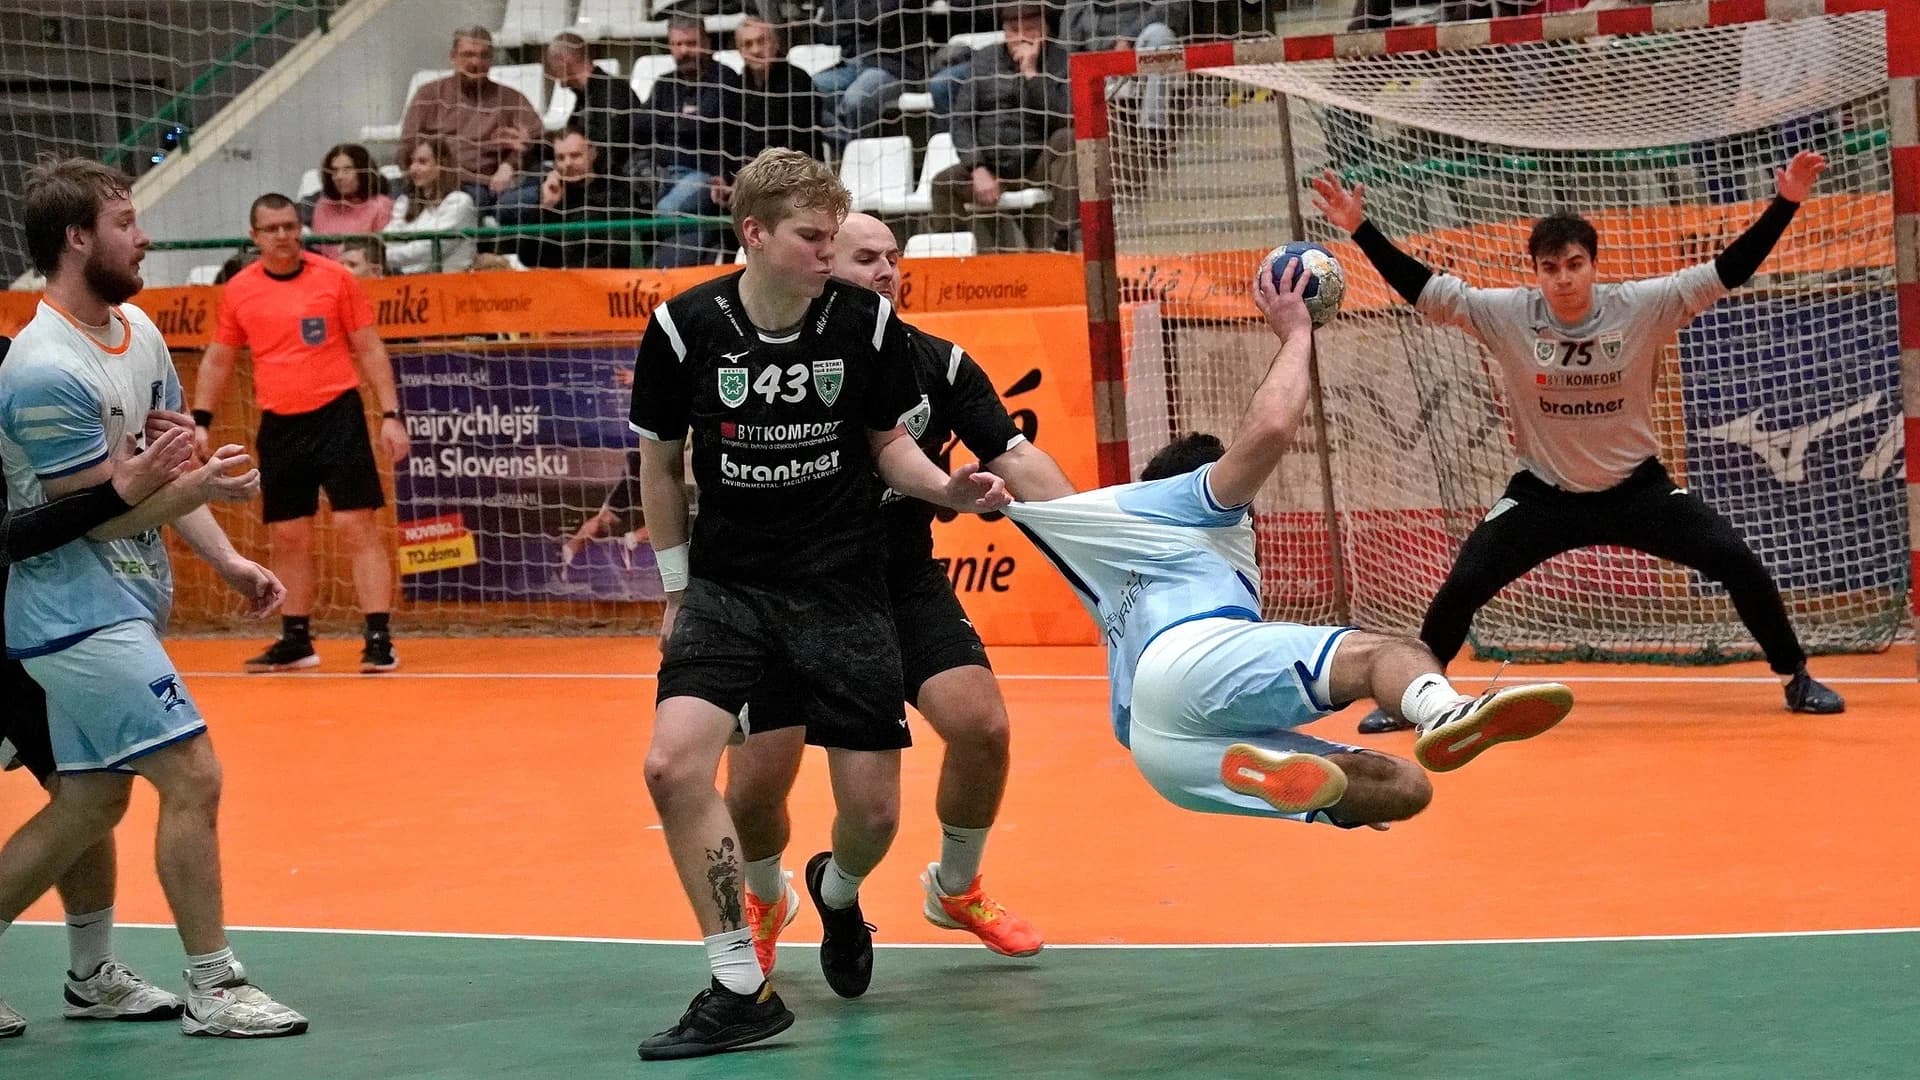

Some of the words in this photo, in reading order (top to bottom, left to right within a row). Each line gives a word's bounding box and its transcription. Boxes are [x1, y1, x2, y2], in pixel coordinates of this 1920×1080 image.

[377, 285, 429, 326] niké
[936, 281, 952, 305] je
[957, 280, 1029, 304] tipovanie
[157, 297, 207, 335] niké
[1560, 341, 1594, 366] 75
[753, 363, 810, 404] 43
[1547, 371, 1622, 387] BYTKOMFORT
[1539, 396, 1624, 415] brantner
[405, 404, 541, 444] najrýchlejší
[738, 420, 843, 441] BYTKOMFORT
[410, 454, 437, 478] na
[440, 446, 568, 478] Slovensku
[721, 450, 840, 481] brantner
[1108, 574, 1153, 649] TURIEC
